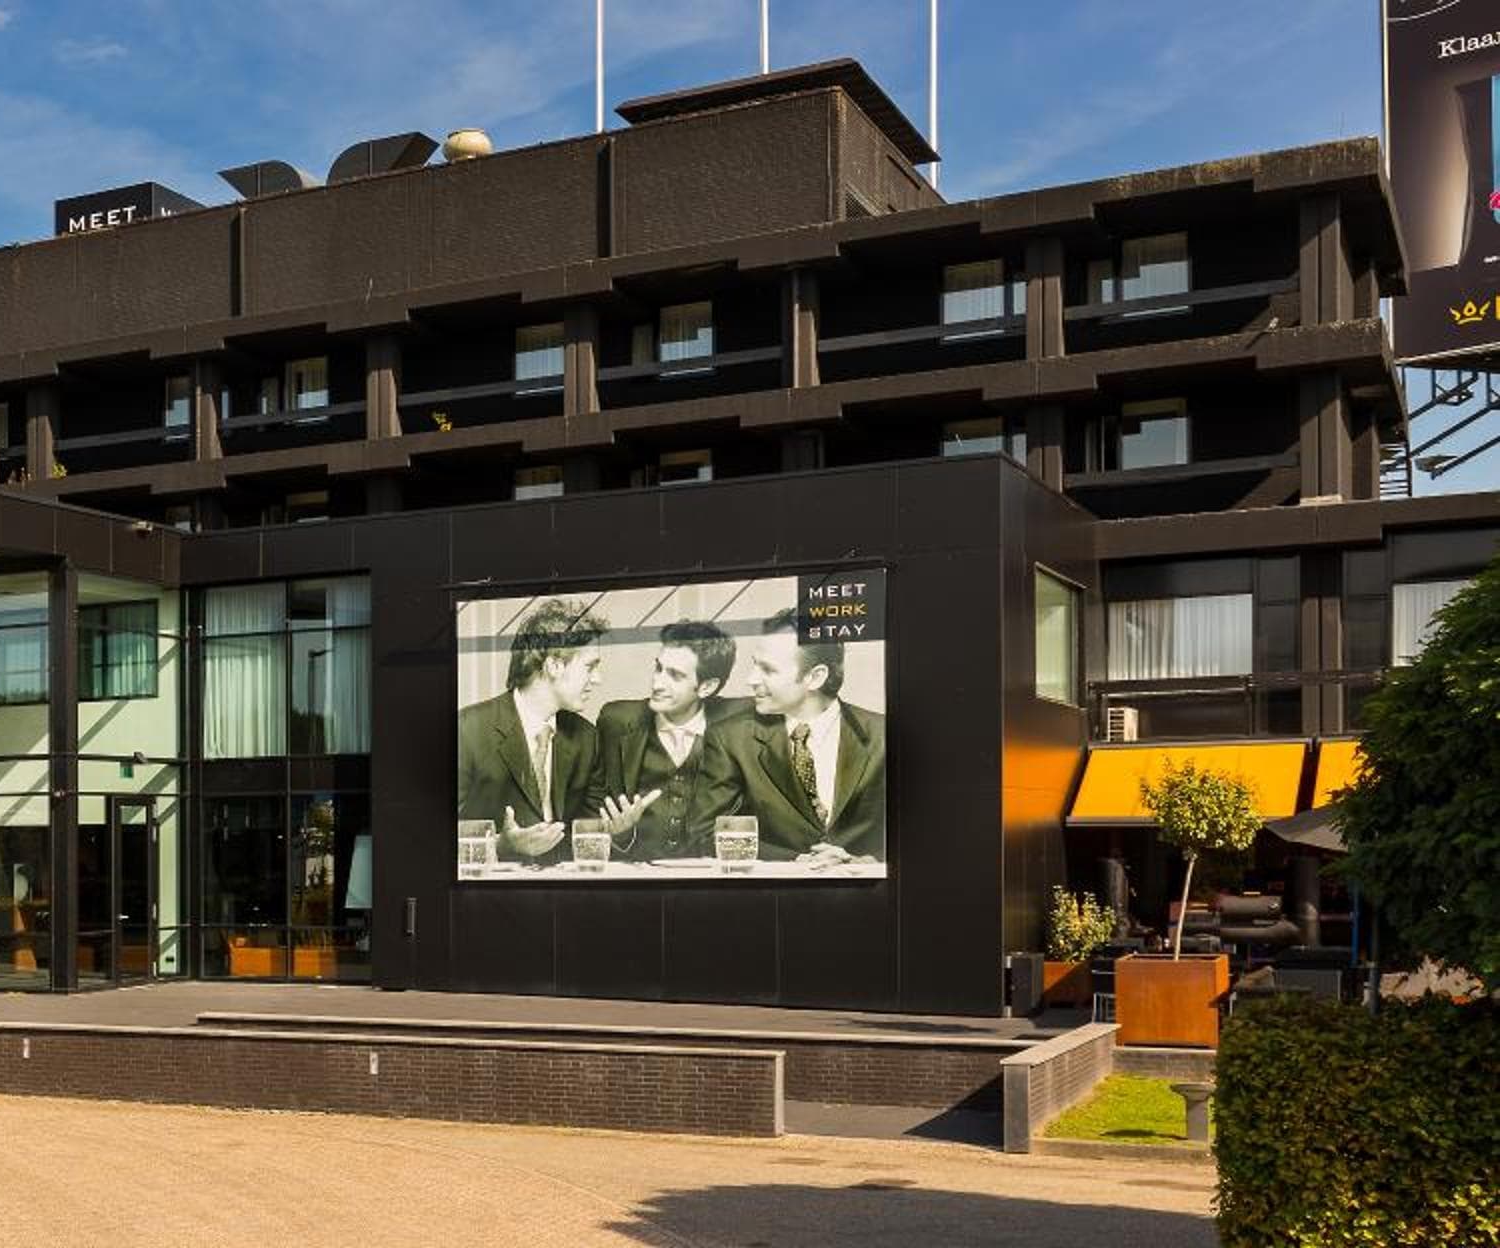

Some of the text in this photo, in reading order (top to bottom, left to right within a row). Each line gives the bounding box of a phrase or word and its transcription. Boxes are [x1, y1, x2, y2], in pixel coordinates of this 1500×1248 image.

[68, 205, 137, 233] MEET
[808, 583, 867, 599] MEET
[808, 603, 867, 618] WORK
[808, 623, 866, 639] STAY
